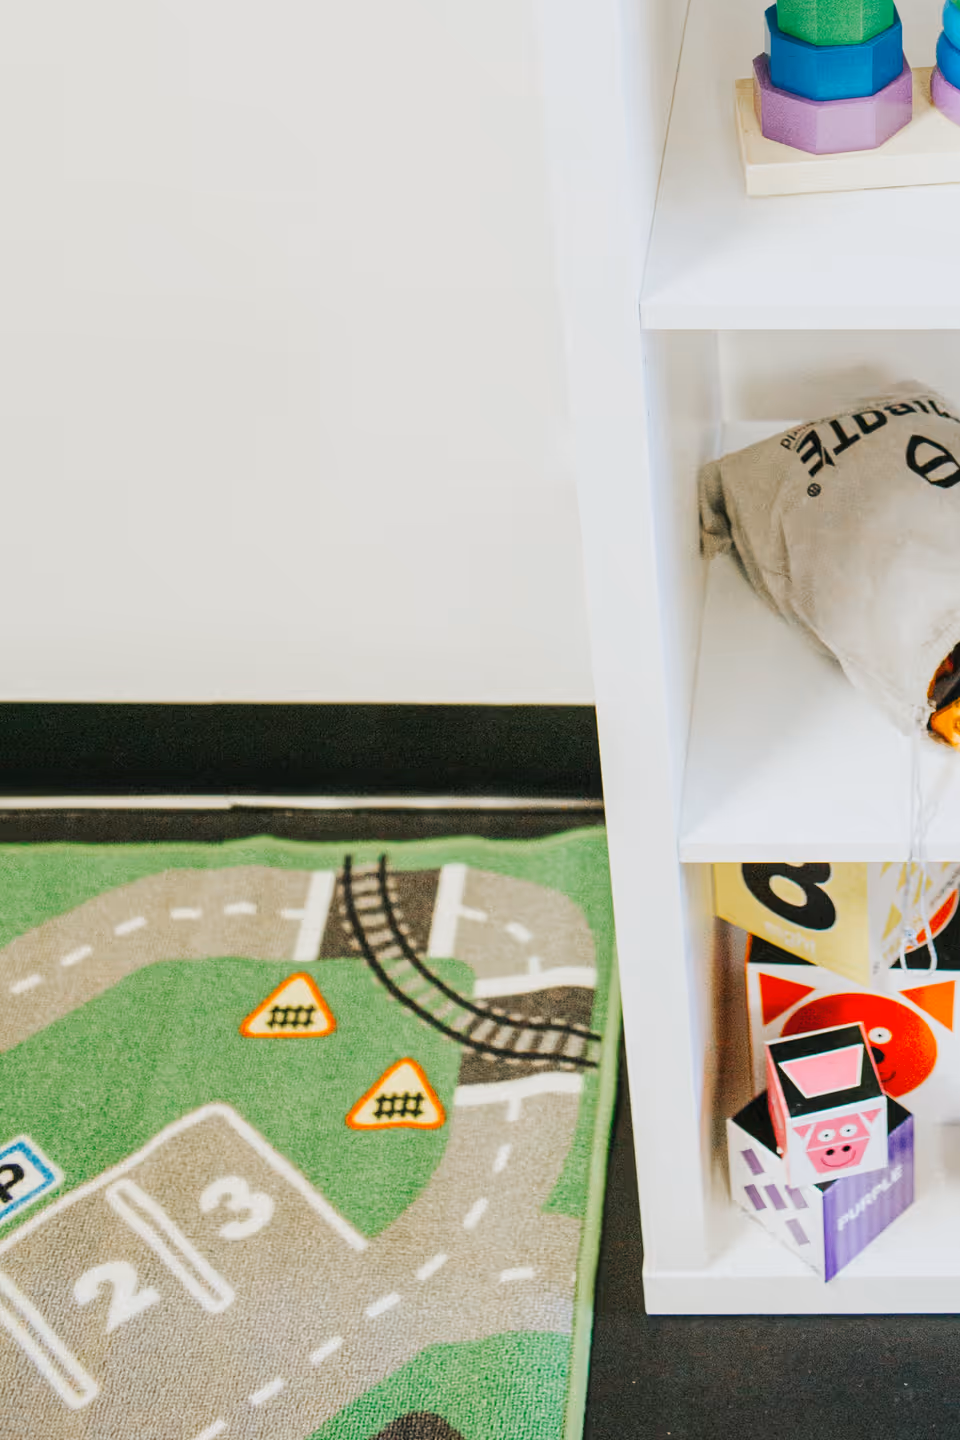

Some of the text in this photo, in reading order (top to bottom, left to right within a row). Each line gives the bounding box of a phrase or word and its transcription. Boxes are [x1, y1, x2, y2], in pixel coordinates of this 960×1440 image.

[199, 1175, 276, 1241] 3
[836, 1163, 903, 1232] PURPLE
[73, 1261, 160, 1333] 2
